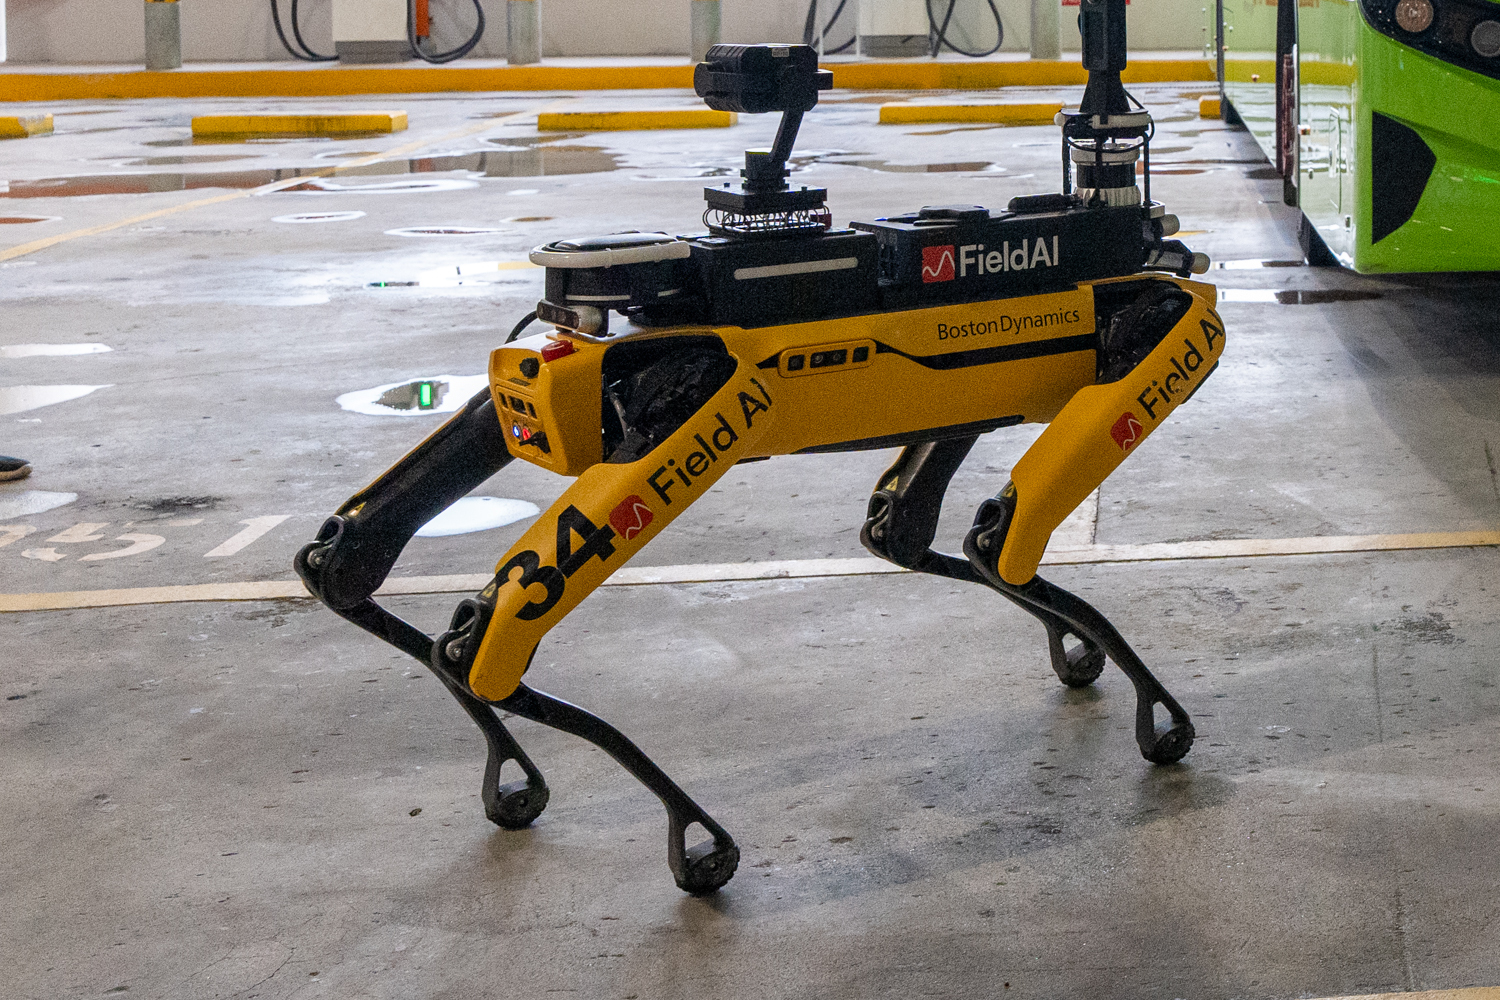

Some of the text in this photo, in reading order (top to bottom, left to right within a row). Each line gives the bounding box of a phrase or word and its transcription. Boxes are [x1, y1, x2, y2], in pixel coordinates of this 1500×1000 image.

[1135, 337, 1204, 420] Field
[496, 503, 617, 621] 34
[646, 412, 739, 506] Field
